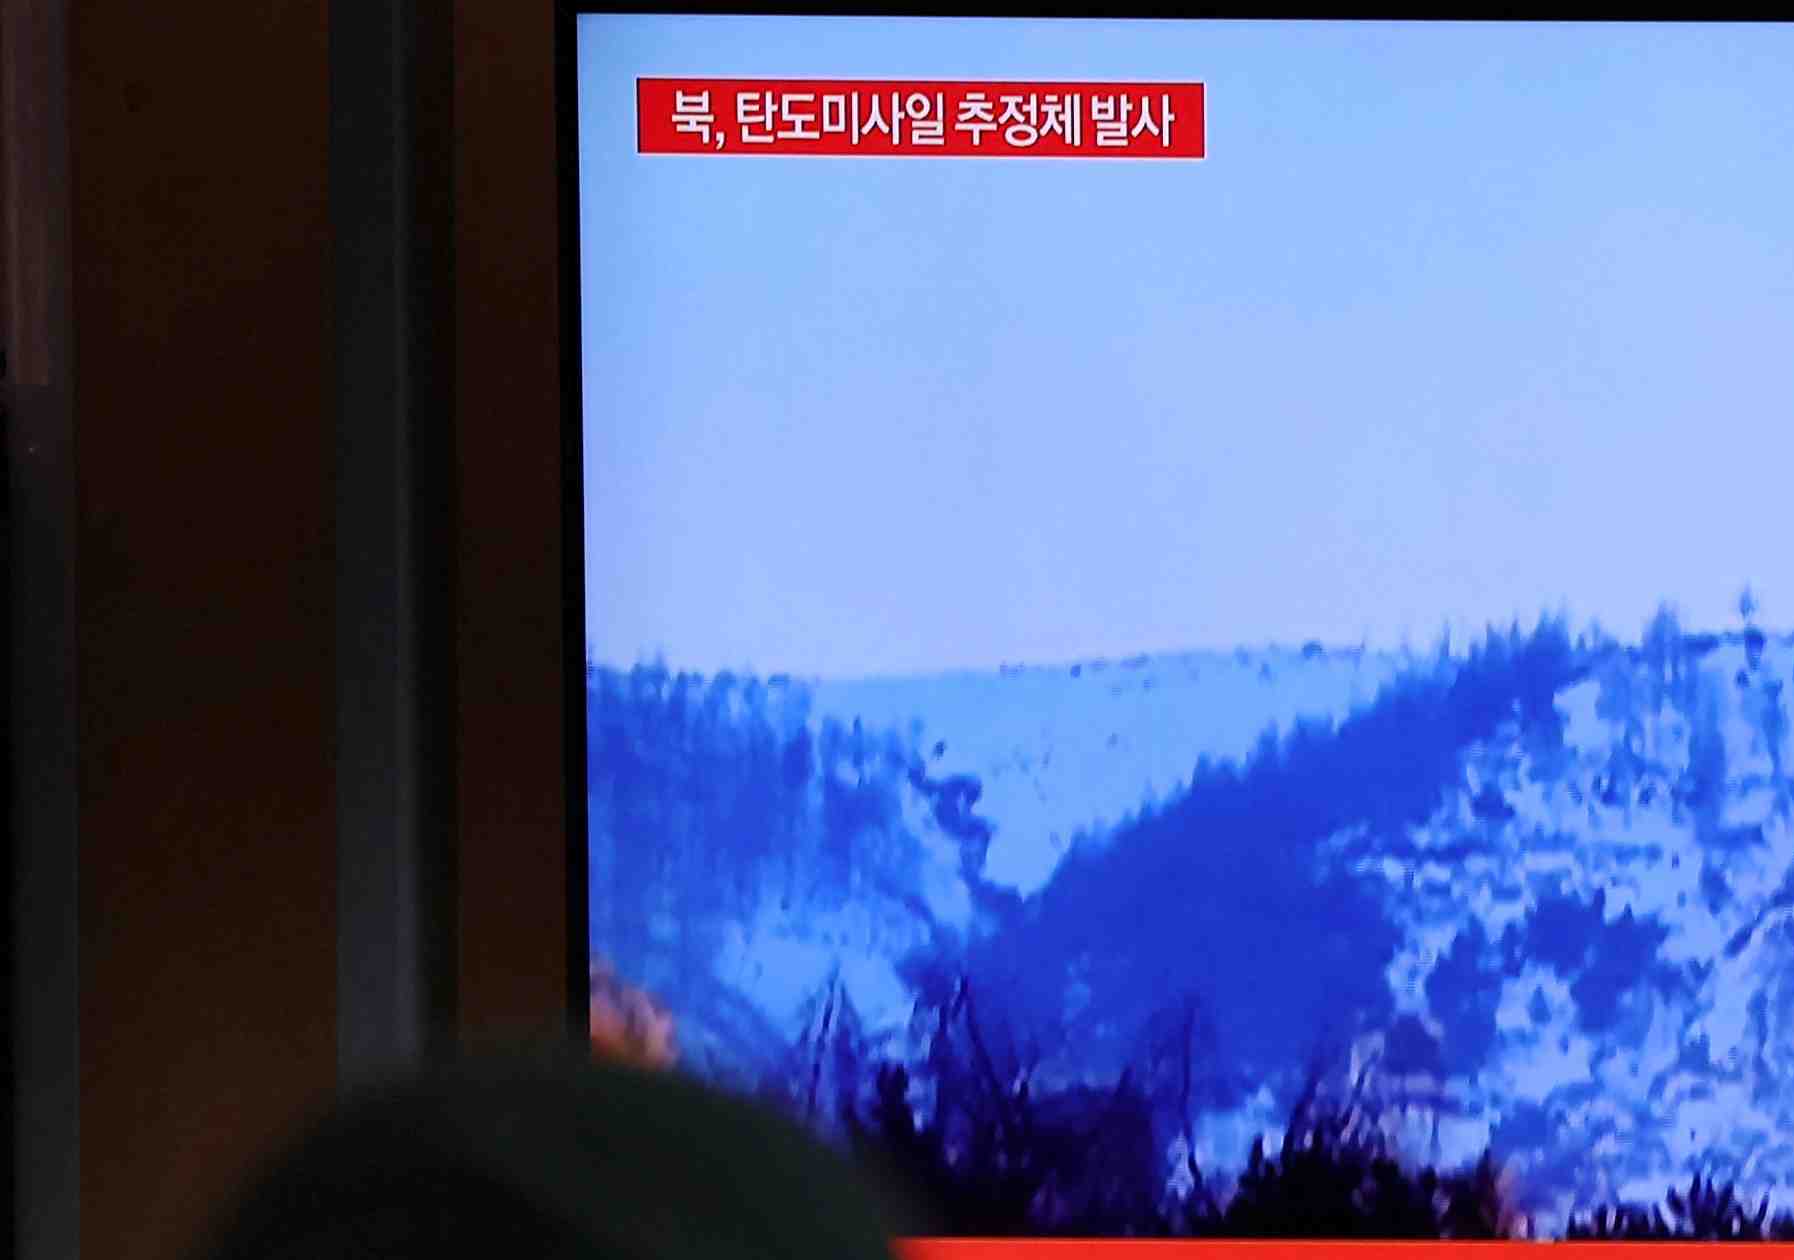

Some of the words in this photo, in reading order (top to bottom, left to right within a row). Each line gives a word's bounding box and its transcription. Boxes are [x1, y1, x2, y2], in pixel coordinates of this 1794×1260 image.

[671, 90, 725, 150] 북,
[736, 91, 945, 145] 탄도미사일
[954, 92, 1081, 147] 추정체
[1091, 94, 1175, 147] 발사
